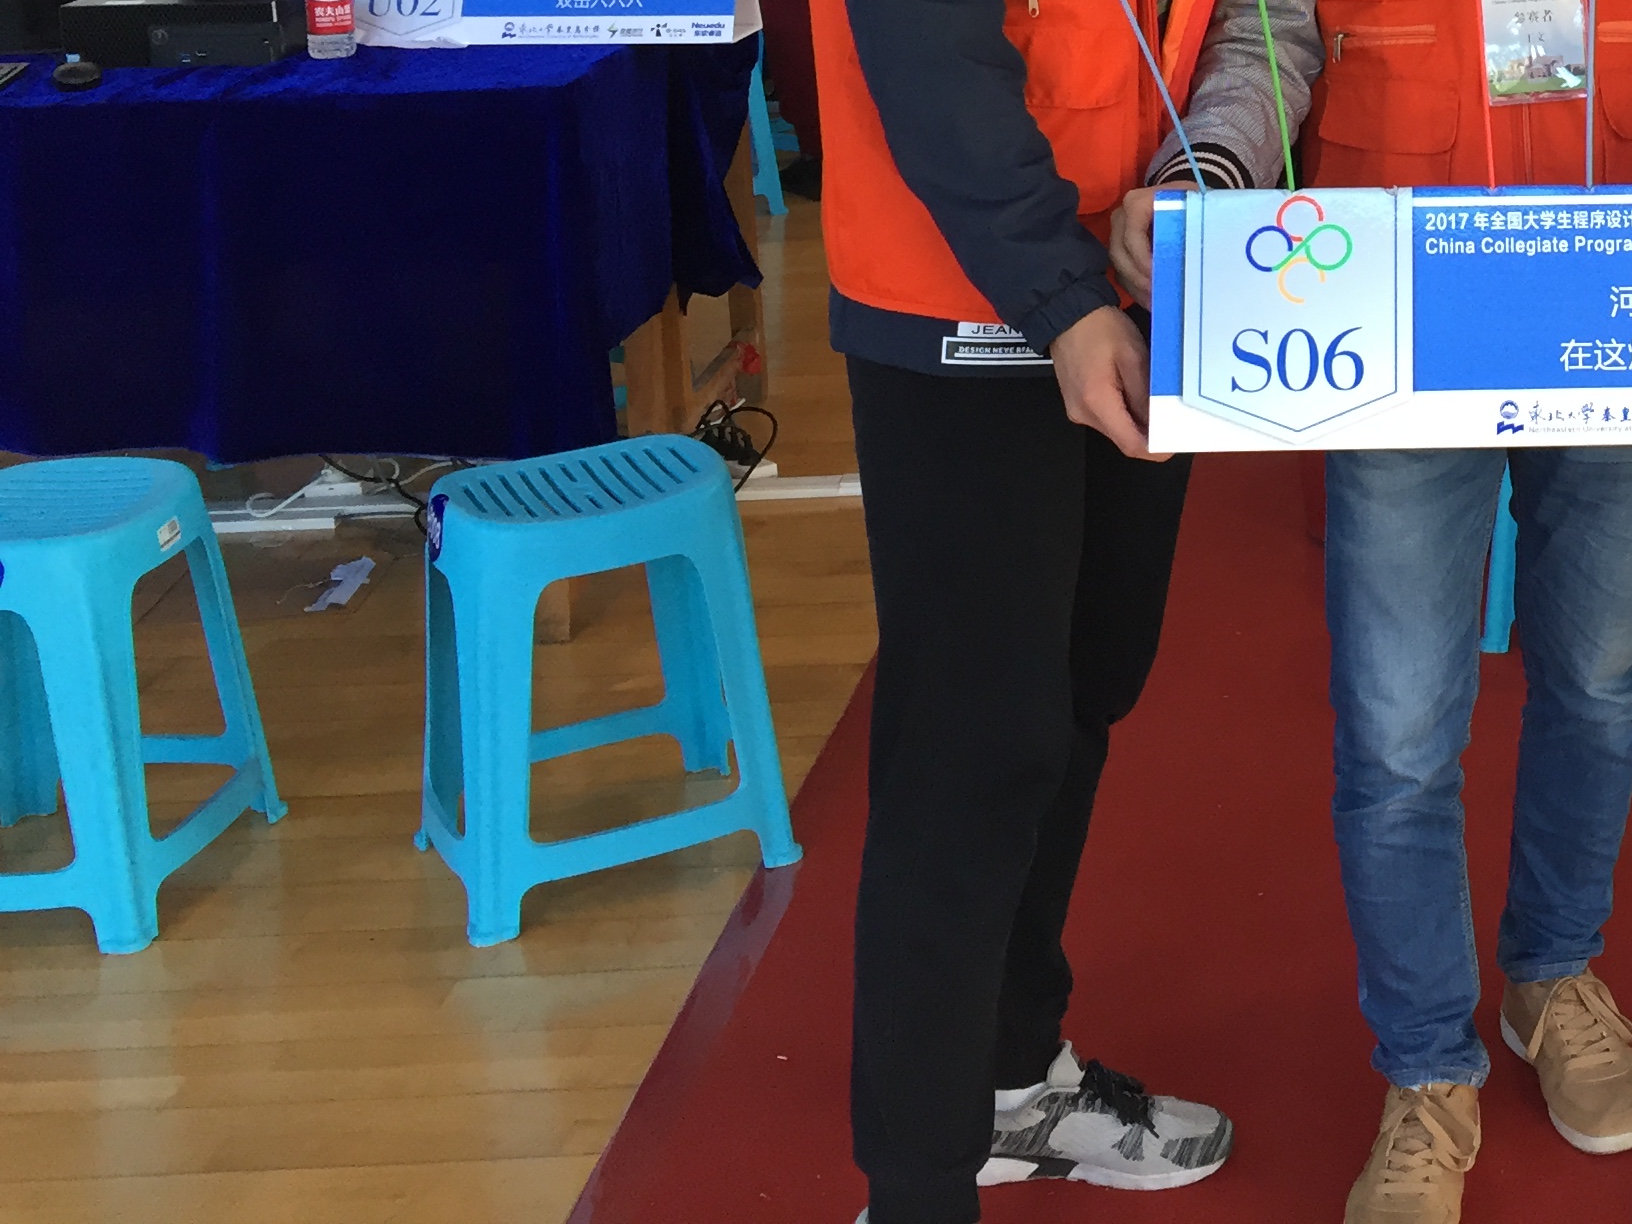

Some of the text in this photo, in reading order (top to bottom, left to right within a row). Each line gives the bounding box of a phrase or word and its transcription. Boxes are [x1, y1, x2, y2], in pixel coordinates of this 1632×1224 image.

[1425, 237, 1475, 254] China
[1481, 236, 1569, 256] Collegiate
[958, 345, 991, 354] DESIGN
[1230, 325, 1365, 394] S06
